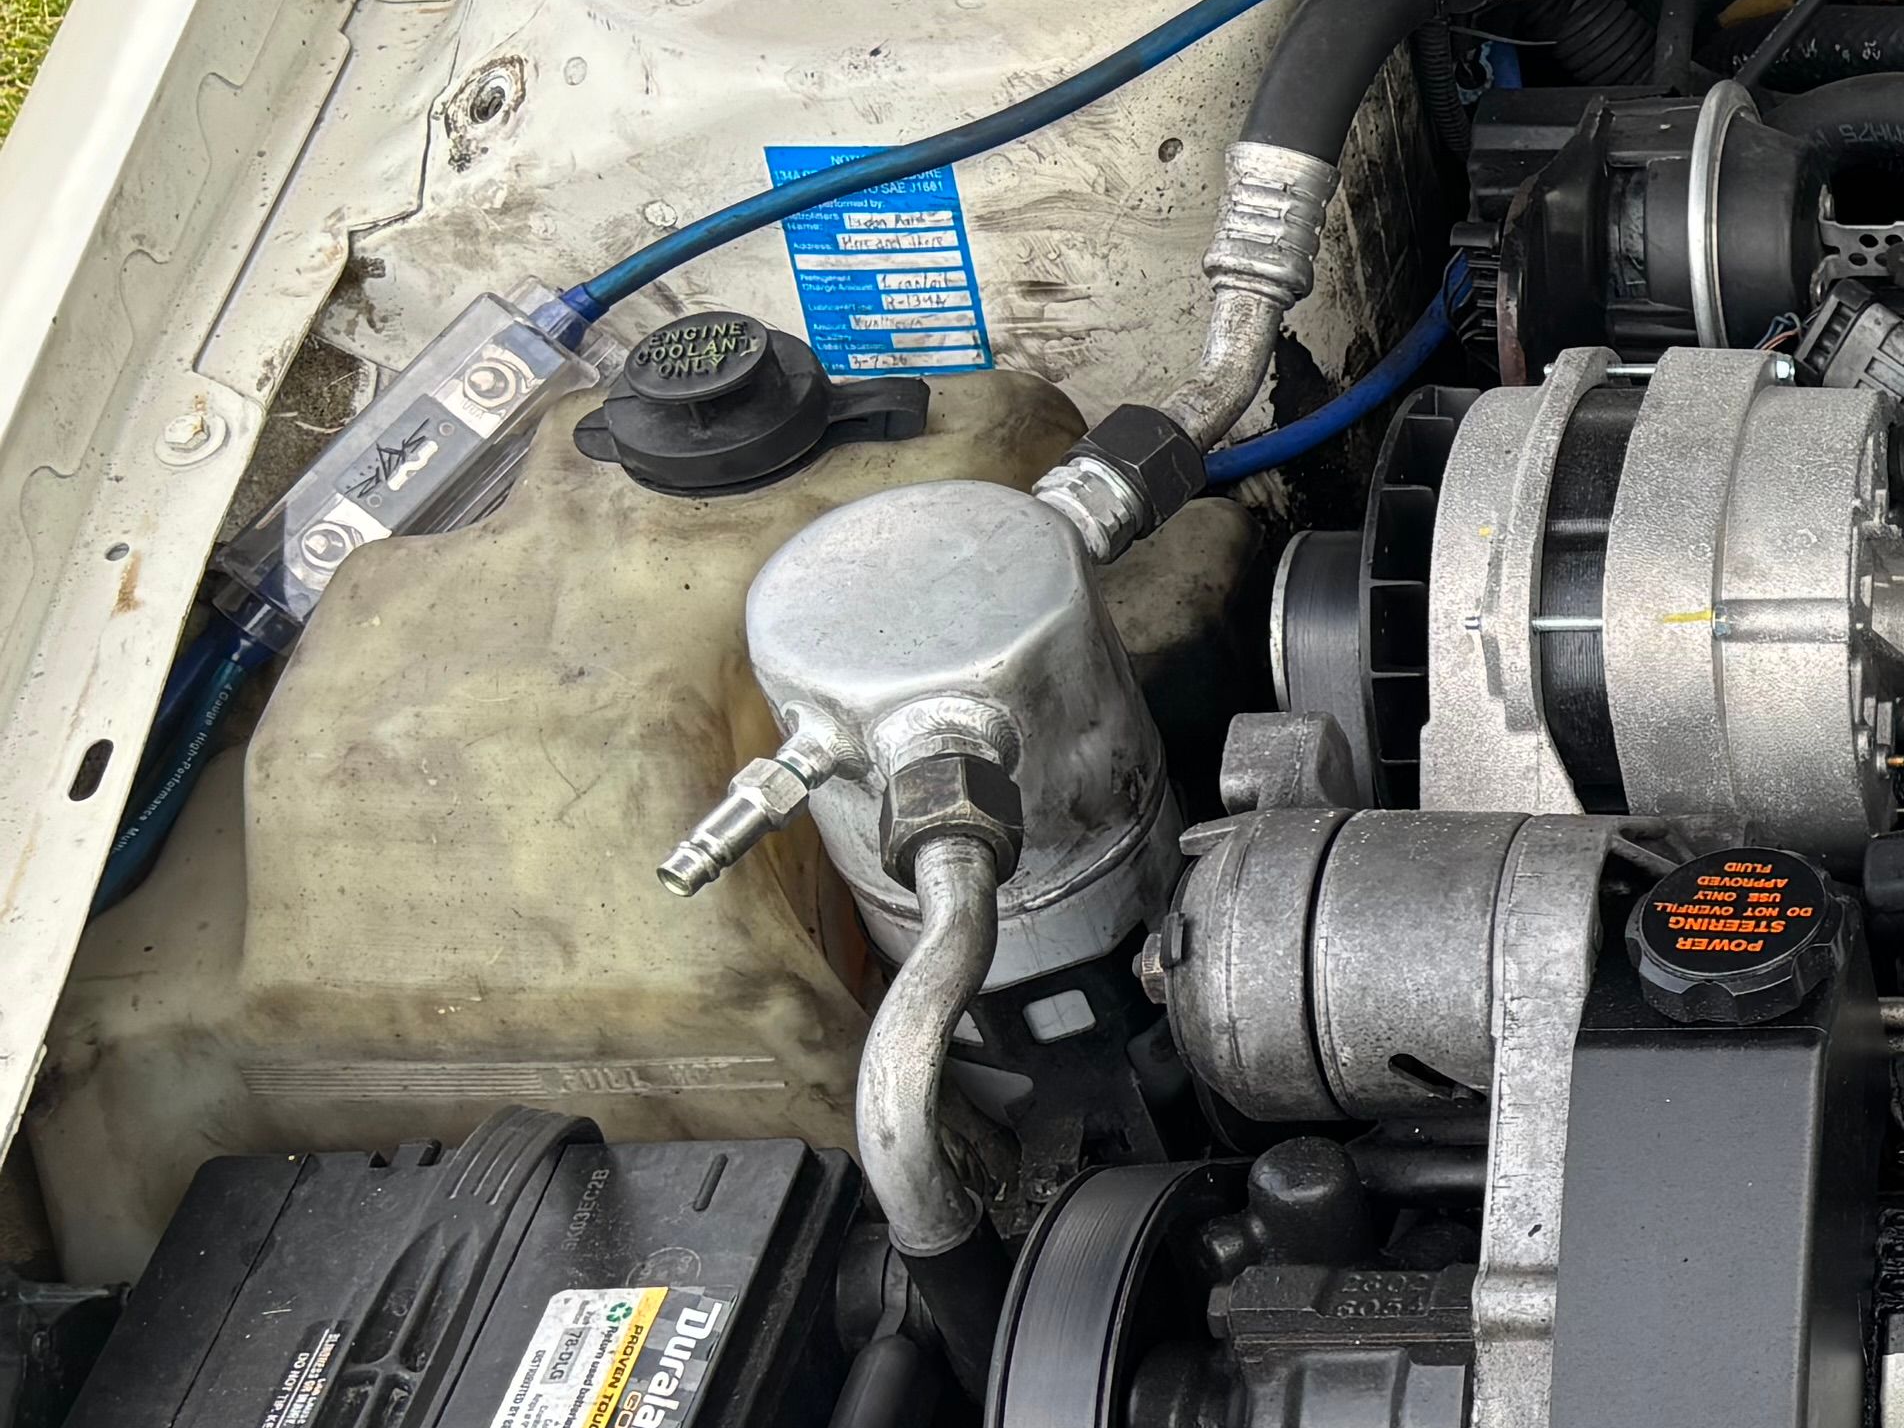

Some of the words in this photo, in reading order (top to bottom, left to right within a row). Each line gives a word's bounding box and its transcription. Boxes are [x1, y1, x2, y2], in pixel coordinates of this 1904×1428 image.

[880, 181, 906, 194] SAE
[649, 322, 748, 346] ENGINE
[636, 335, 757, 366] COOLANT
[658, 355, 724, 379] ONLY
[206, 691, 229, 727] Gauge
[1724, 862, 1773, 874] FLUID
[1697, 876, 1789, 888] APPROVED
[1694, 891, 1737, 902] ONLY
[1747, 892, 1781, 902] USE
[1653, 902, 1734, 916] OVERFILL
[1743, 906, 1780, 917] NOT
[1786, 907, 1813, 917] DO
[1668, 916, 1786, 933] STEERING
[1675, 936, 1764, 952] POWER
[593, 1326, 619, 1358] Return
[607, 1324, 644, 1390] PROVEN
